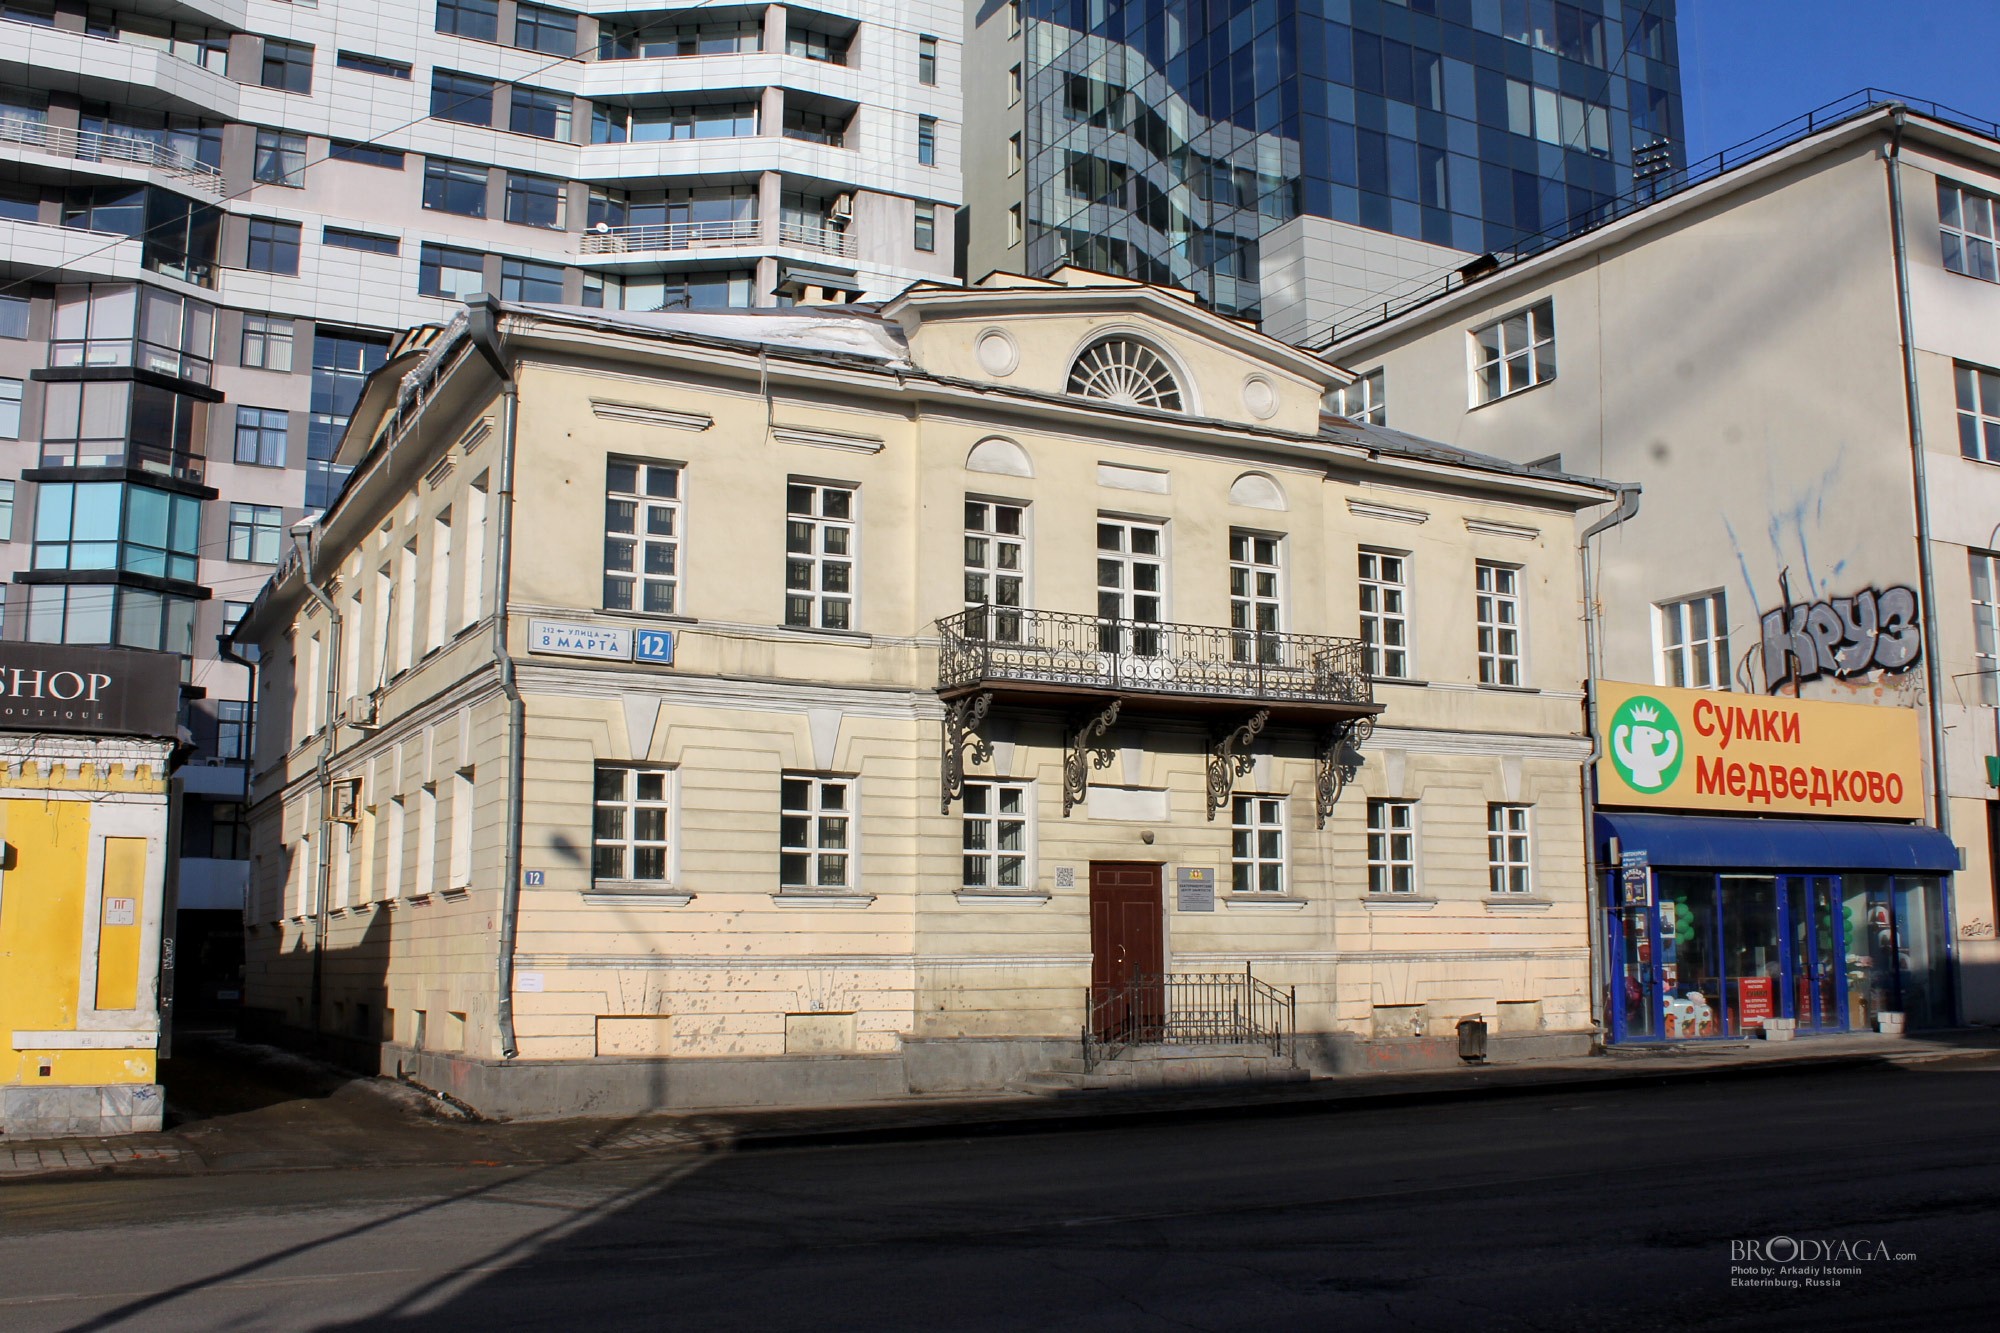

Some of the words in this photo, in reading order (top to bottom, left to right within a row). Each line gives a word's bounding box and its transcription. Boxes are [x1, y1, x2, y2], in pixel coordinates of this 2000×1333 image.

[542, 626, 555, 634] 212
[568, 628, 600, 638] УЛИЦА
[542, 635, 551, 646] 8
[557, 637, 619, 652] МАРТА
[642, 635, 665, 656] 12
[1693, 698, 1801, 749] Сумки
[1696, 755, 1904, 808] Медведково
[529, 872, 540, 885] 12
[114, 899, 126, 909] ПГ
